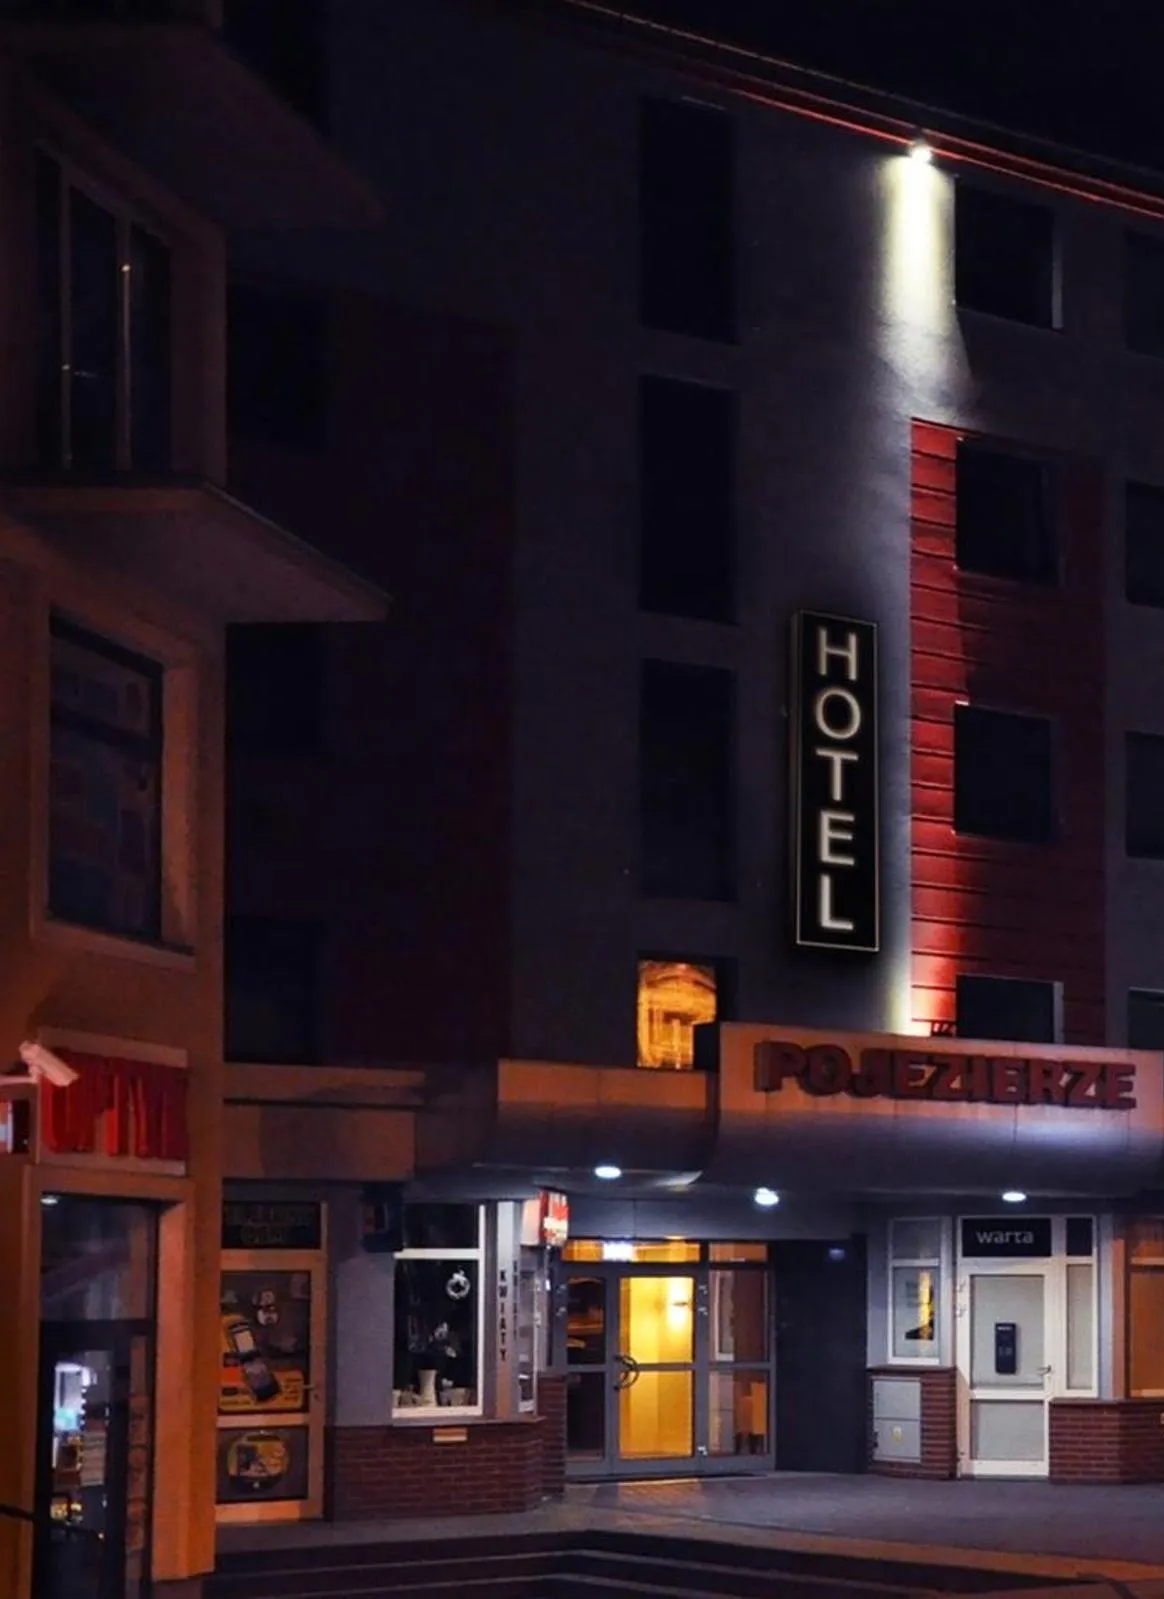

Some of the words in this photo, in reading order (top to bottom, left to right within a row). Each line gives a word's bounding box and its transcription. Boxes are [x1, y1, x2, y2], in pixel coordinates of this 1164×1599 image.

[815, 627, 861, 931] HOTEL
[754, 1040, 1137, 1109] POJEZIERZE
[975, 1229, 1035, 1245] warta
